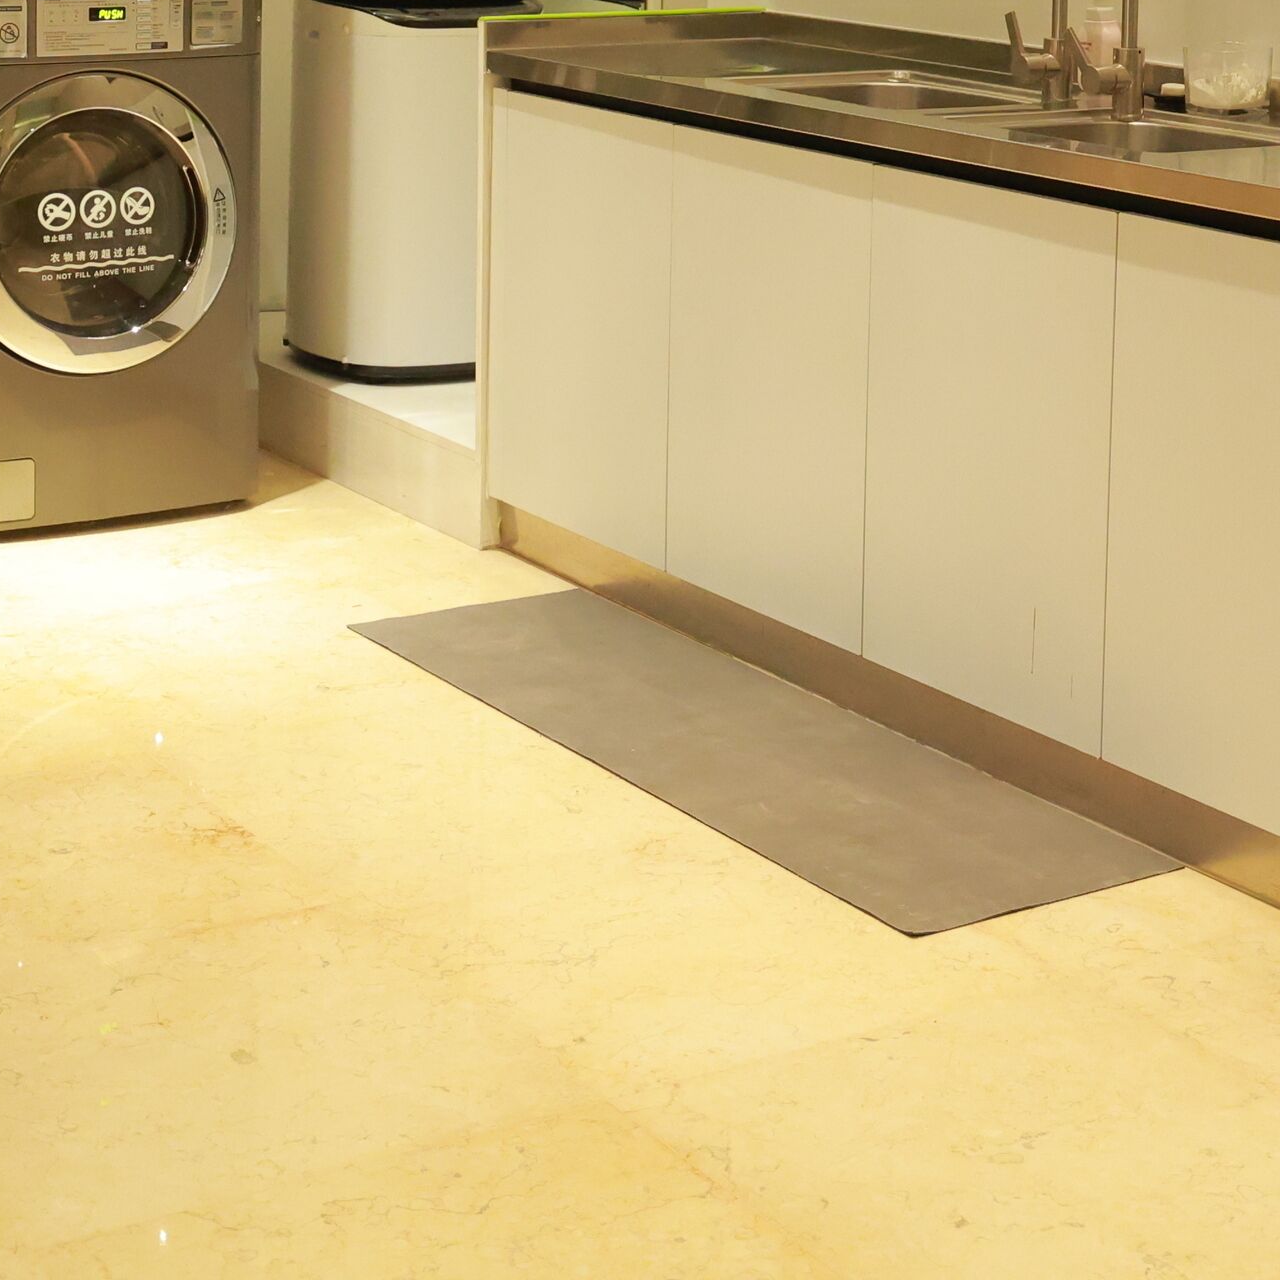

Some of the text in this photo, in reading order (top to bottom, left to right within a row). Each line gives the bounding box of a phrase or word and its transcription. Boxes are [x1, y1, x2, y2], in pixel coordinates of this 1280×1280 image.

[99, 10, 123, 19] PUSH
[50, 246, 150, 266] 衣物请勿超过此线
[94, 268, 119, 277] ABOVE
